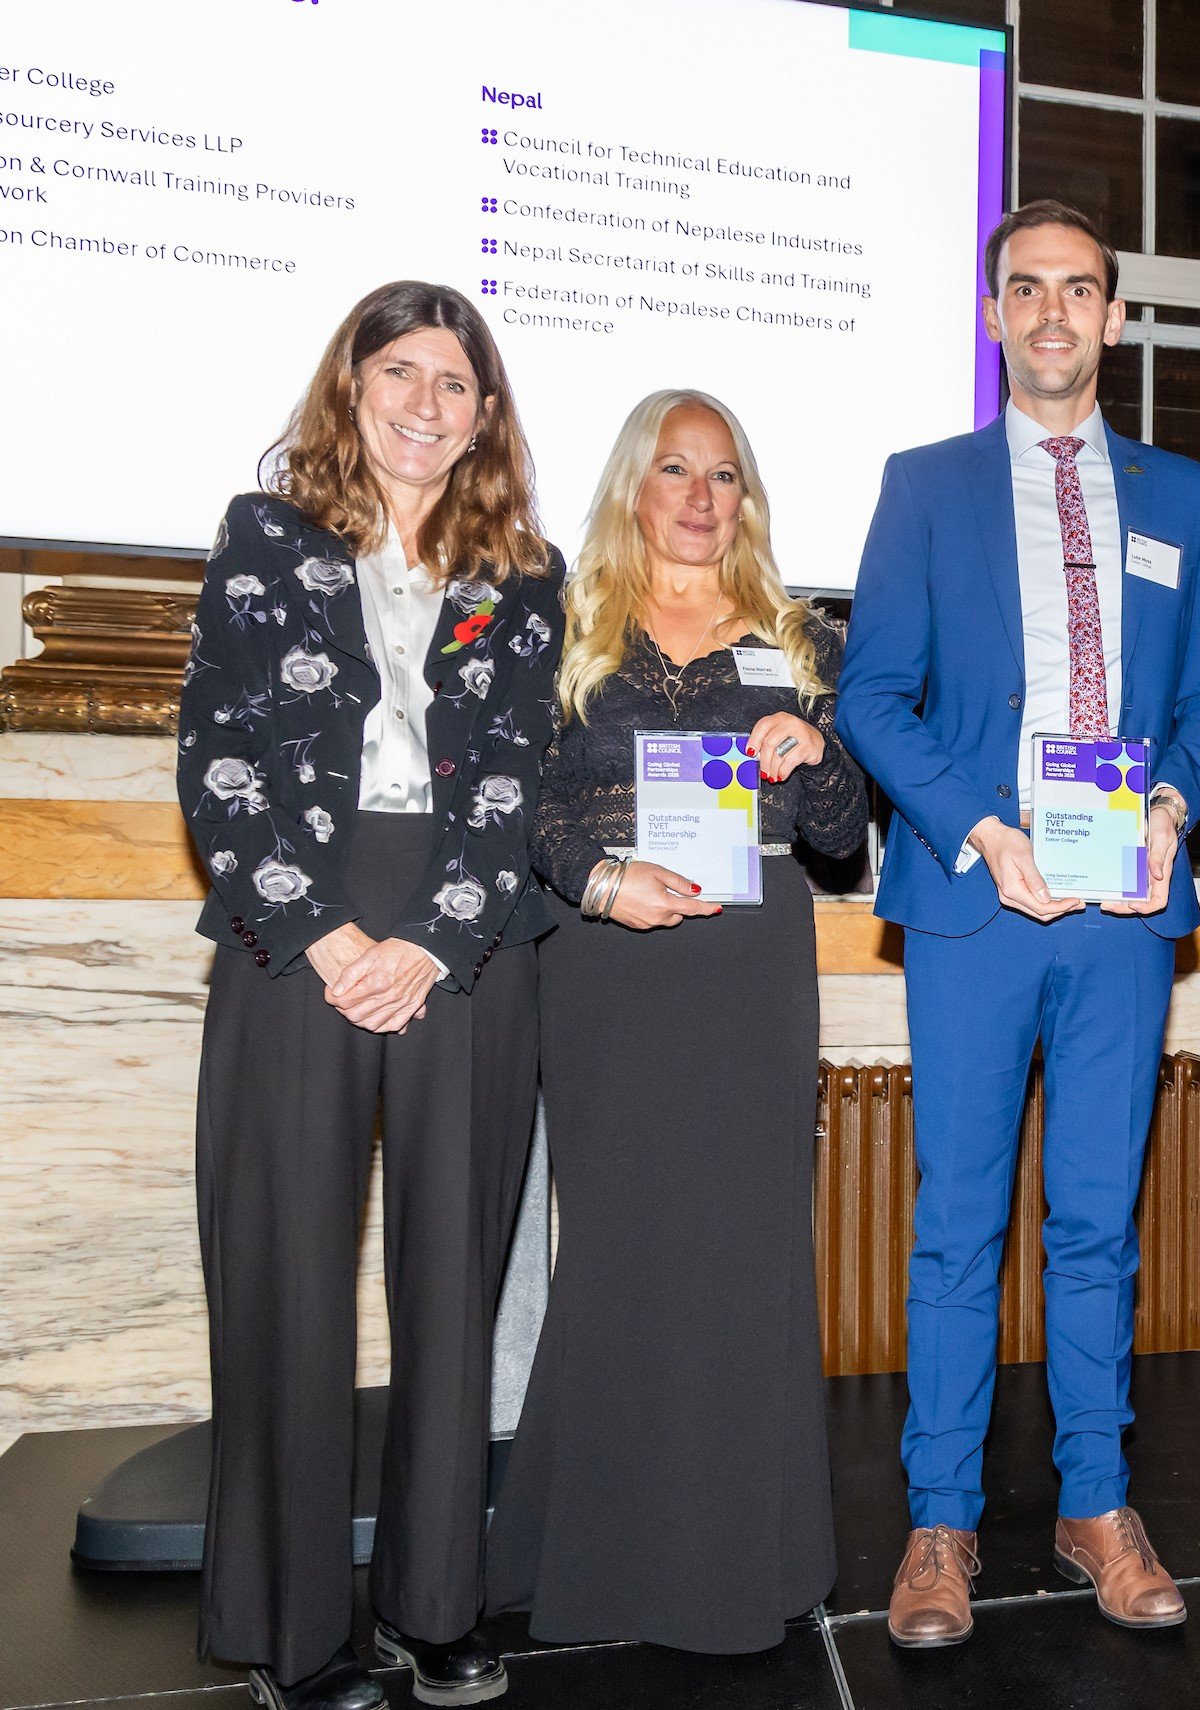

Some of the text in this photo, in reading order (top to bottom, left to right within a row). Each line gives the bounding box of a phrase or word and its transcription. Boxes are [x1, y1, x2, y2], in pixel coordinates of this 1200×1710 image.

[27, 68, 115, 98] College
[481, 86, 543, 110] Nepal
[101, 122, 197, 149] Services
[204, 133, 243, 154] LLP
[503, 130, 851, 190] Council for Technical Education and
[30, 156, 46, 174] &
[53, 159, 157, 188] Cornwall
[162, 171, 249, 202] Training
[256, 183, 355, 210] Providers
[502, 157, 691, 200] Vocational Training
[503, 200, 863, 256] Confederation of Nepalese Industries
[31, 229, 139, 258] Chamber
[145, 243, 167, 260] of
[173, 245, 296, 274] Commerce
[503, 240, 872, 299] Nepal Secretariat of Skills and Training
[503, 281, 856, 332] Federation of Nepalese Chambers of
[503, 308, 614, 334] Commerce
[648, 814, 700, 824] Outstanding
[648, 822, 669, 830] TVET
[1045, 811, 1094, 822] Outstanding
[1045, 819, 1065, 828] TVET
[648, 830, 697, 839] Partnership
[1045, 827, 1091, 837] Partnership
